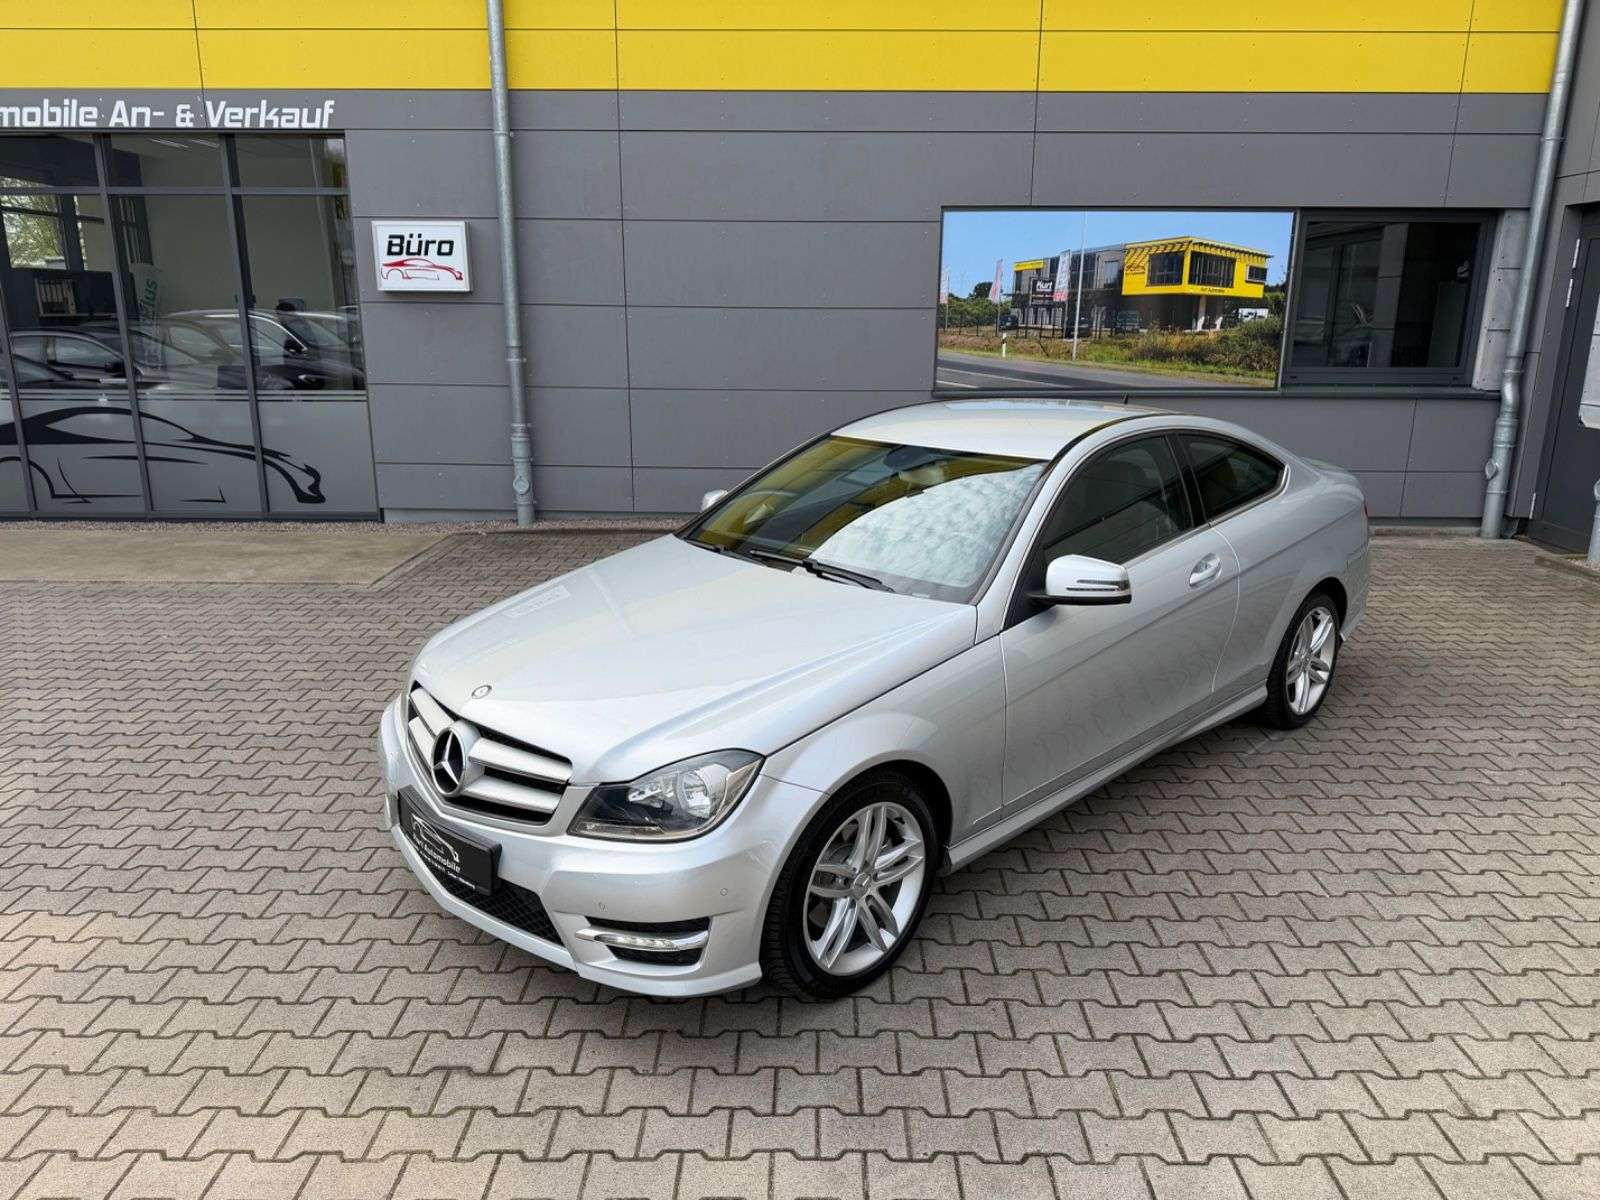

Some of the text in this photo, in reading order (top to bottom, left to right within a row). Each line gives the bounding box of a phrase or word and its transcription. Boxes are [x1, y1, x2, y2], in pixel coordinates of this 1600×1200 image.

[109, 100, 165, 128] An-
[175, 104, 194, 128] &
[205, 99, 335, 129] Verkauf
[387, 233, 455, 256] Büro
